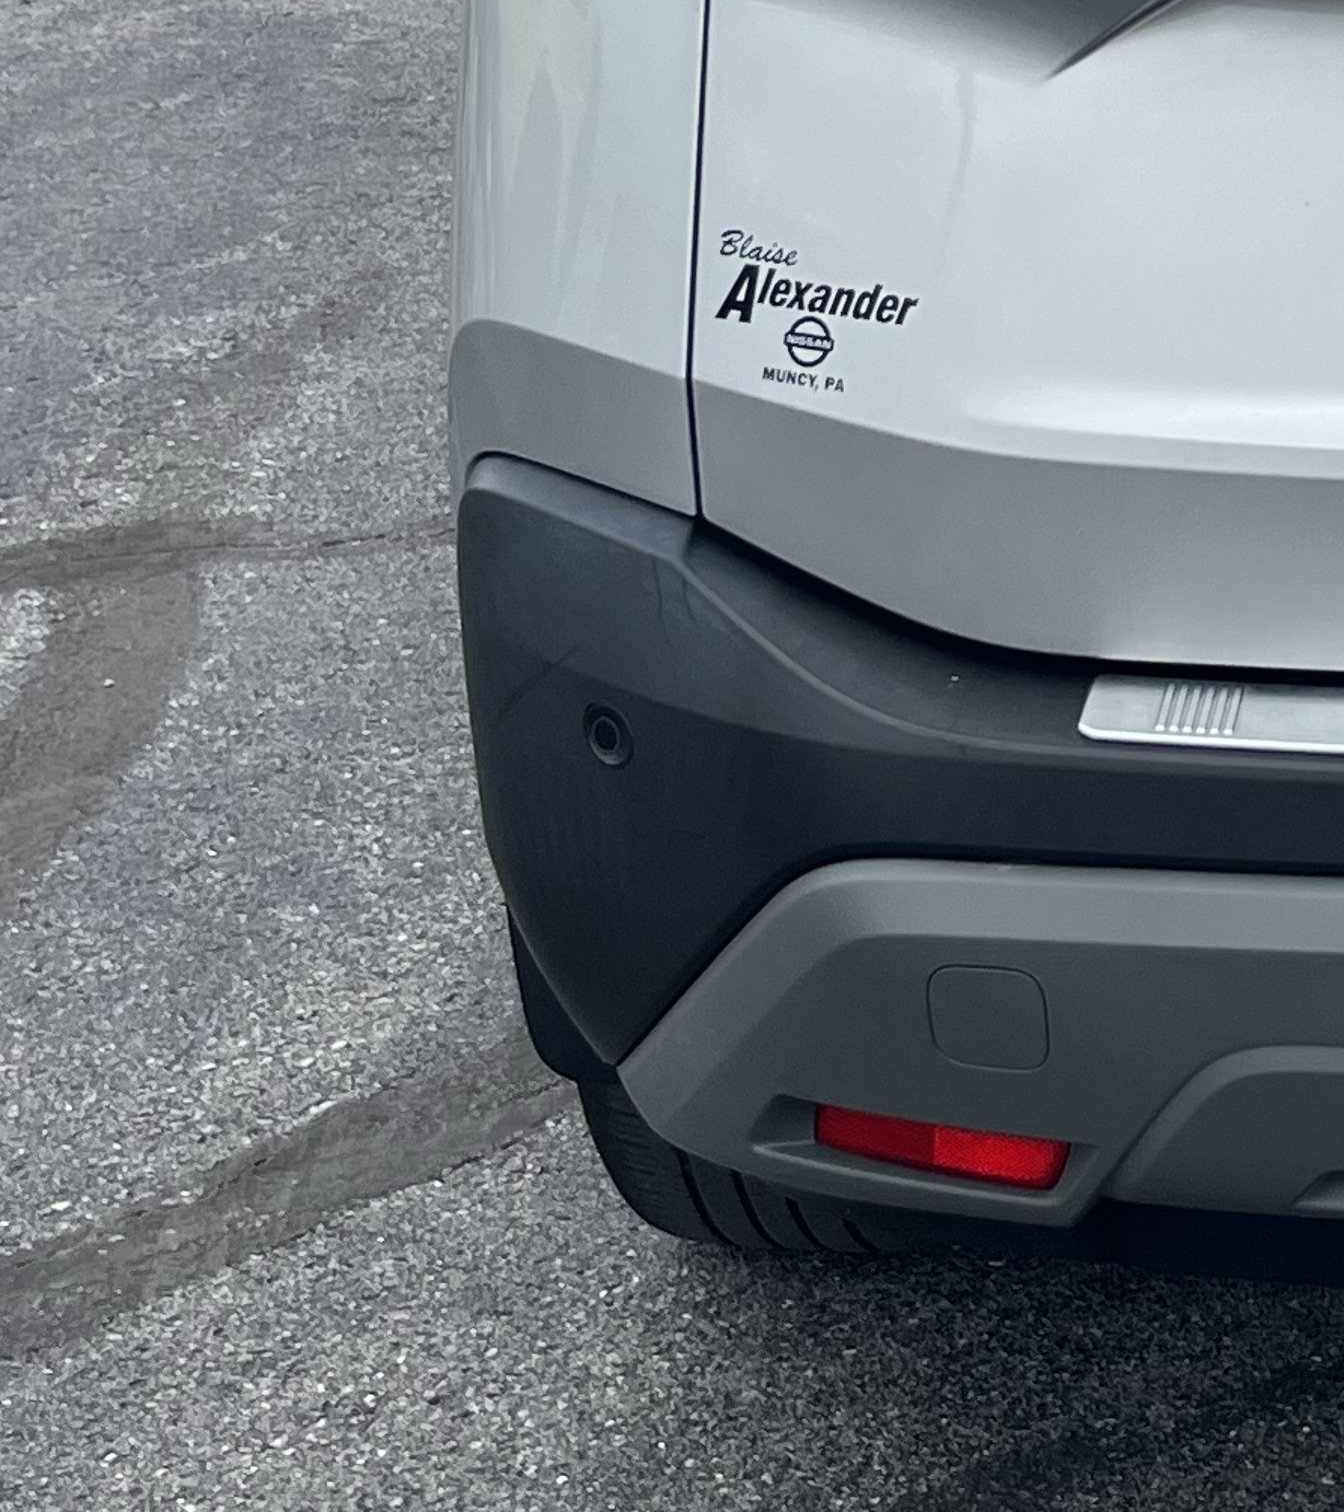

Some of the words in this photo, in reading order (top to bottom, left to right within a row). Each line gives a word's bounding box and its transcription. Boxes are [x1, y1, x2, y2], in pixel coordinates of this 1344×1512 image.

[719, 230, 798, 266] Blaise
[715, 264, 919, 324] Alexander
[762, 367, 819, 391] MUNCY,
[824, 376, 844, 392] PA
